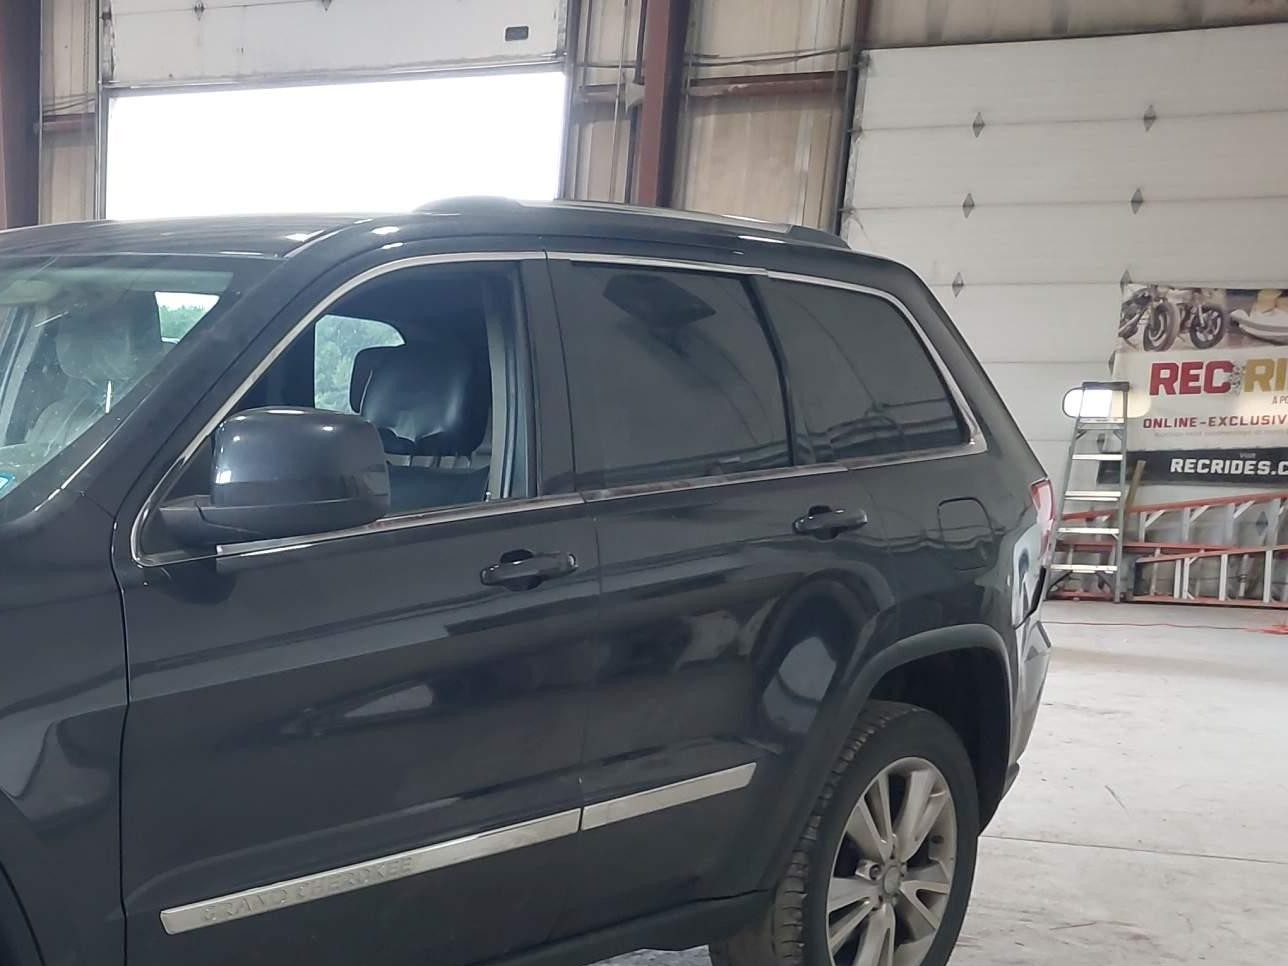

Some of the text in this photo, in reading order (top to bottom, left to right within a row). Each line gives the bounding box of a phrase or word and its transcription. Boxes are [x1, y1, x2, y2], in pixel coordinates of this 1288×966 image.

[1149, 361, 1234, 396] REC
[1143, 415, 1288, 429] ONLINE-EXCLUSIV
[1170, 459, 1288, 475] RECRIDES.C
[204, 857, 414, 921] GRAND CHEROKEE
